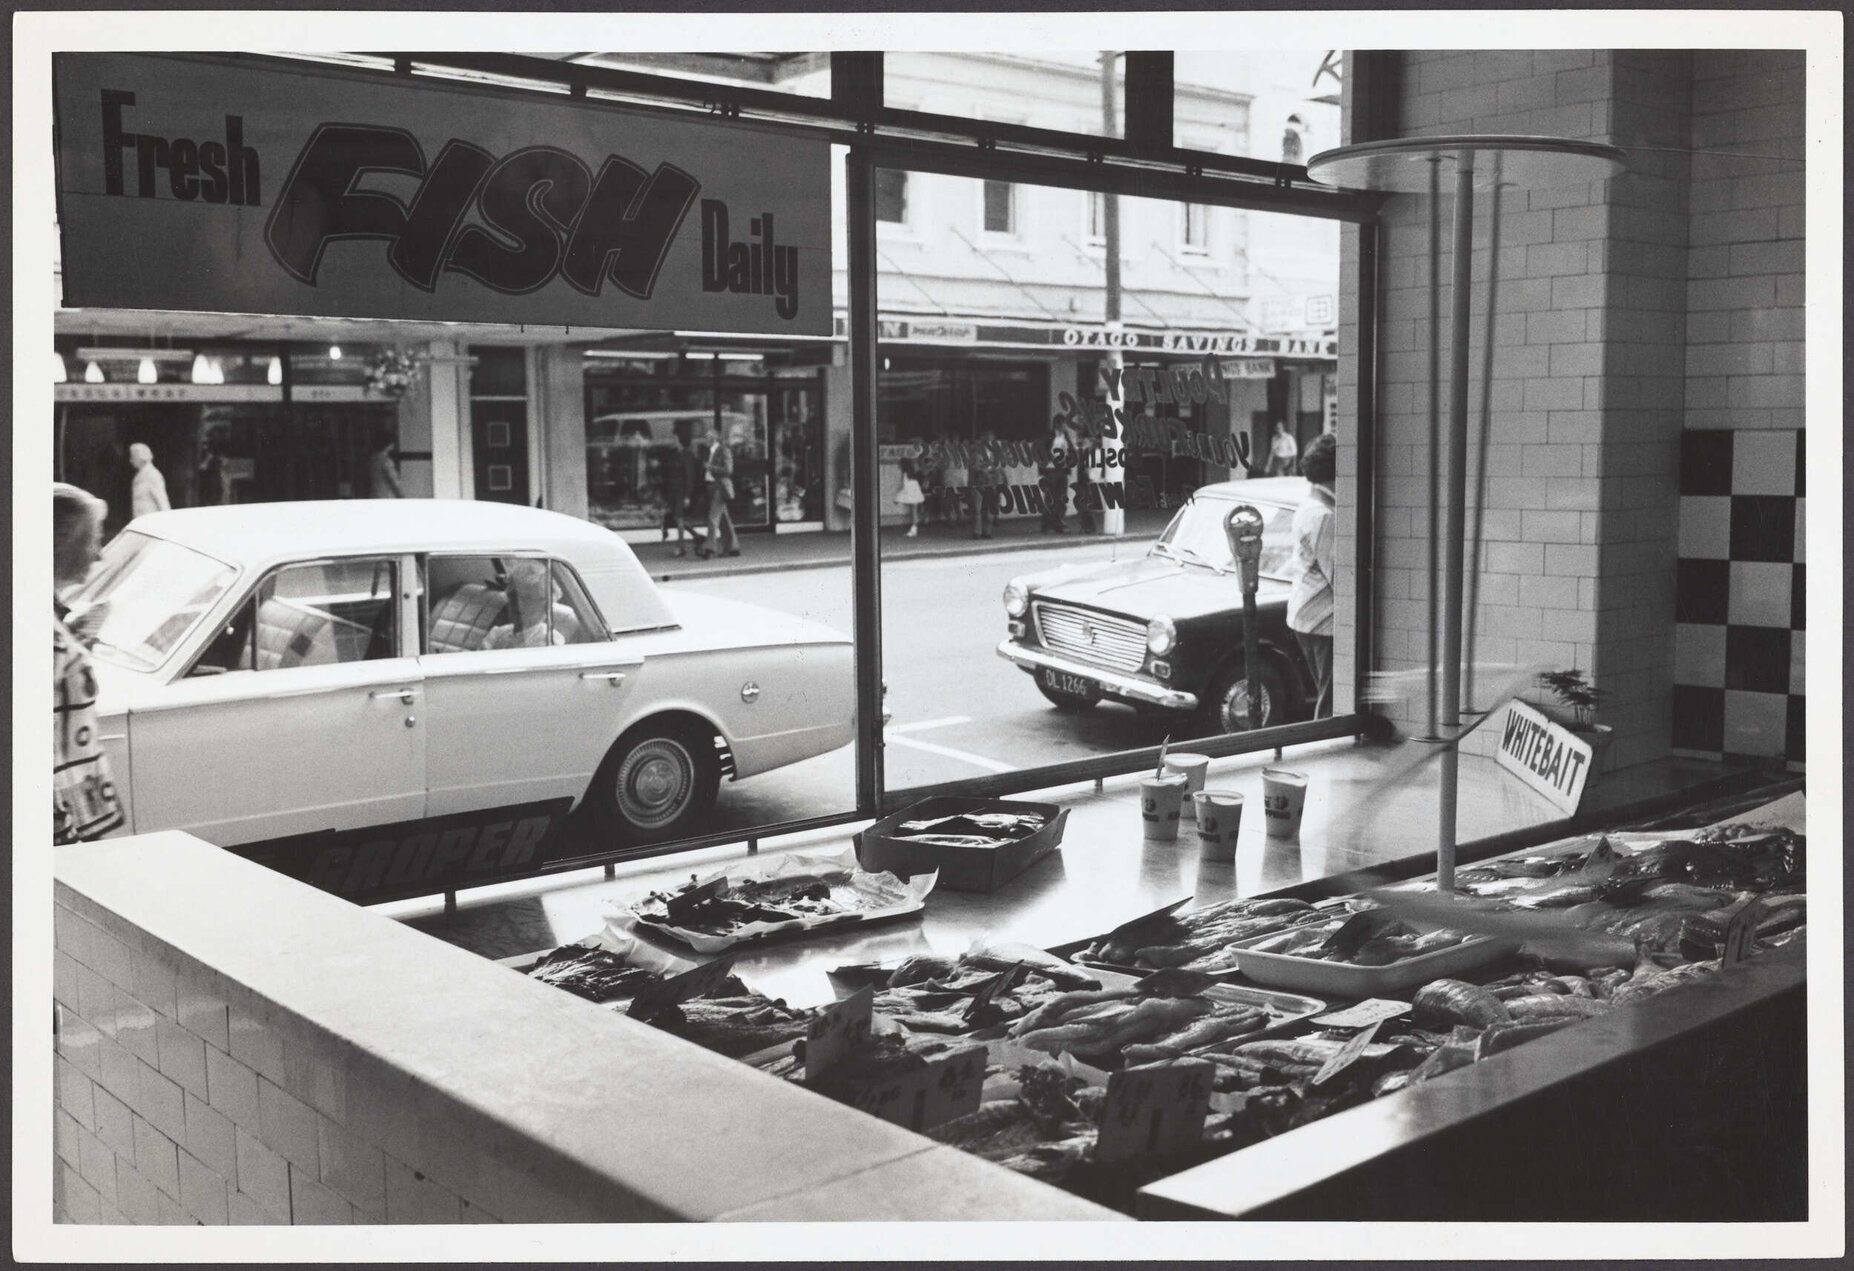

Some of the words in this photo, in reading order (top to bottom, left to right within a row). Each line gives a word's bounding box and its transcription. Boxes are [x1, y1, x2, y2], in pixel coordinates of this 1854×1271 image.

[100, 88, 262, 207] Fresh
[264, 121, 702, 300] FISH
[700, 199, 799, 321] Daily
[1064, 330, 1139, 347] OTAGO
[1162, 336, 1257, 354] SAVINGS
[1279, 339, 1331, 360] BANK
[1502, 708, 1586, 797] WHITEBAIT
